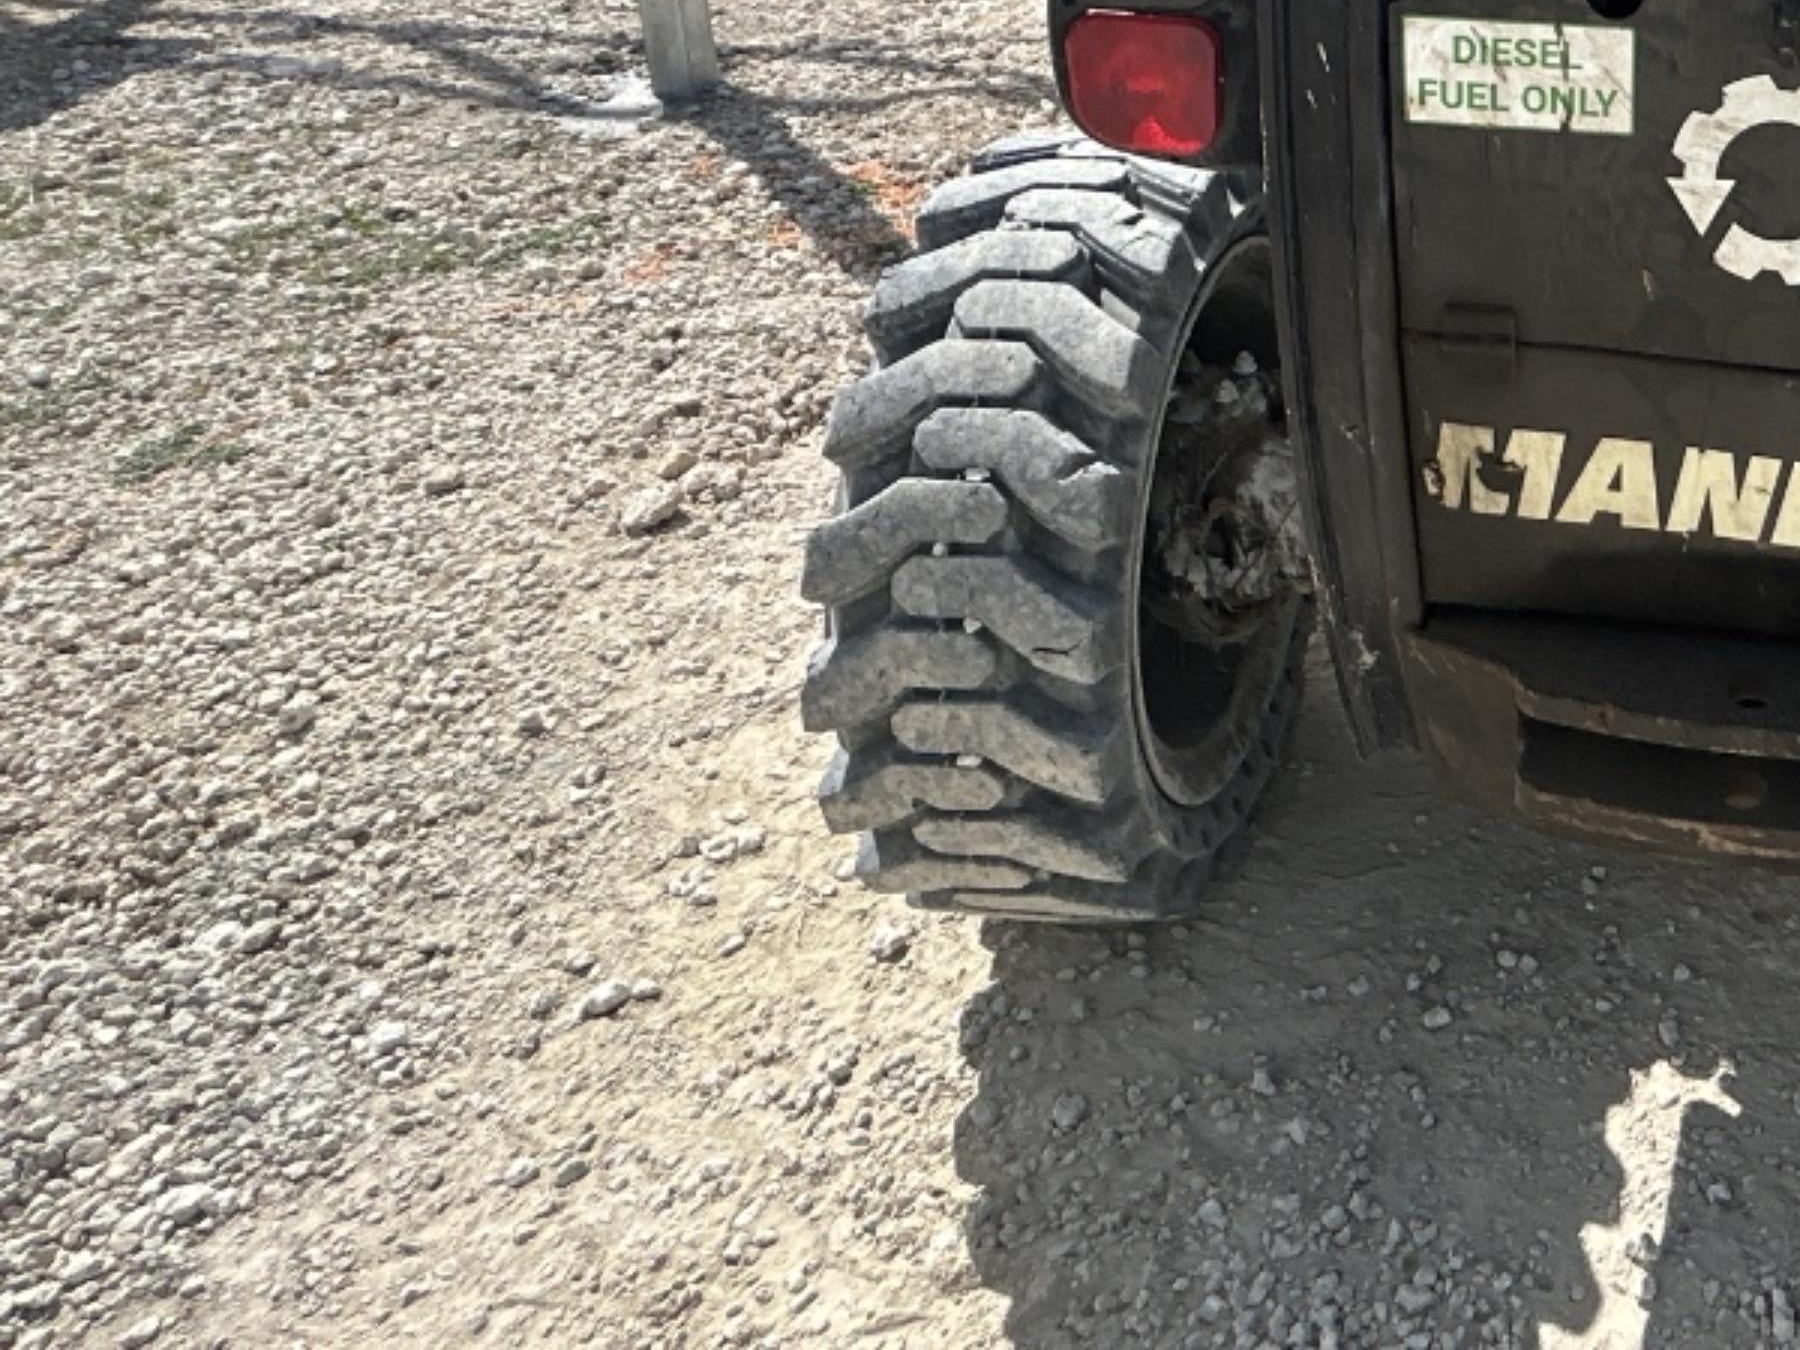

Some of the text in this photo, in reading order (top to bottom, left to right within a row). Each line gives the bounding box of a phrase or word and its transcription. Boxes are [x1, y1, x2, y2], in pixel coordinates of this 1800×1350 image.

[1452, 35, 1583, 70] DIESEL
[1418, 78, 1618, 118] FUEL ONLY
